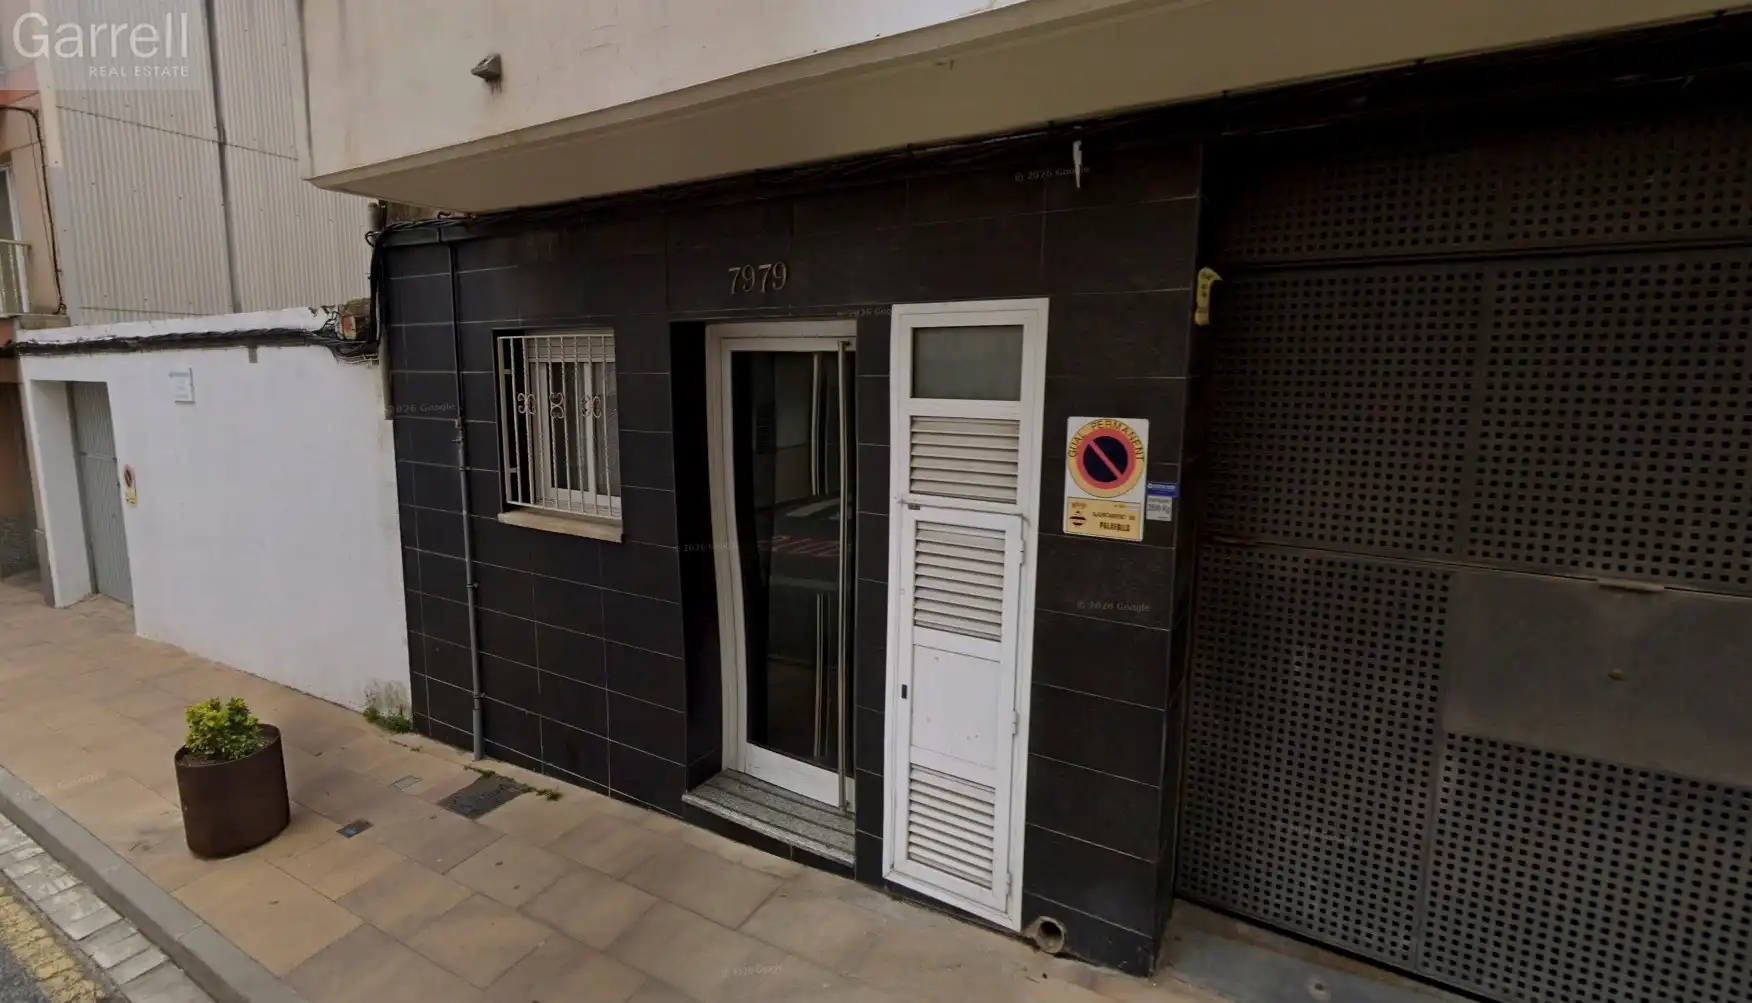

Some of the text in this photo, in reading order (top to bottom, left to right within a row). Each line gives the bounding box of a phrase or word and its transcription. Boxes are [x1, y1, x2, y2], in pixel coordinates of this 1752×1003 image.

[728, 261, 787, 295] 7979
[1067, 419, 1145, 462] GUAL PERMANENT
